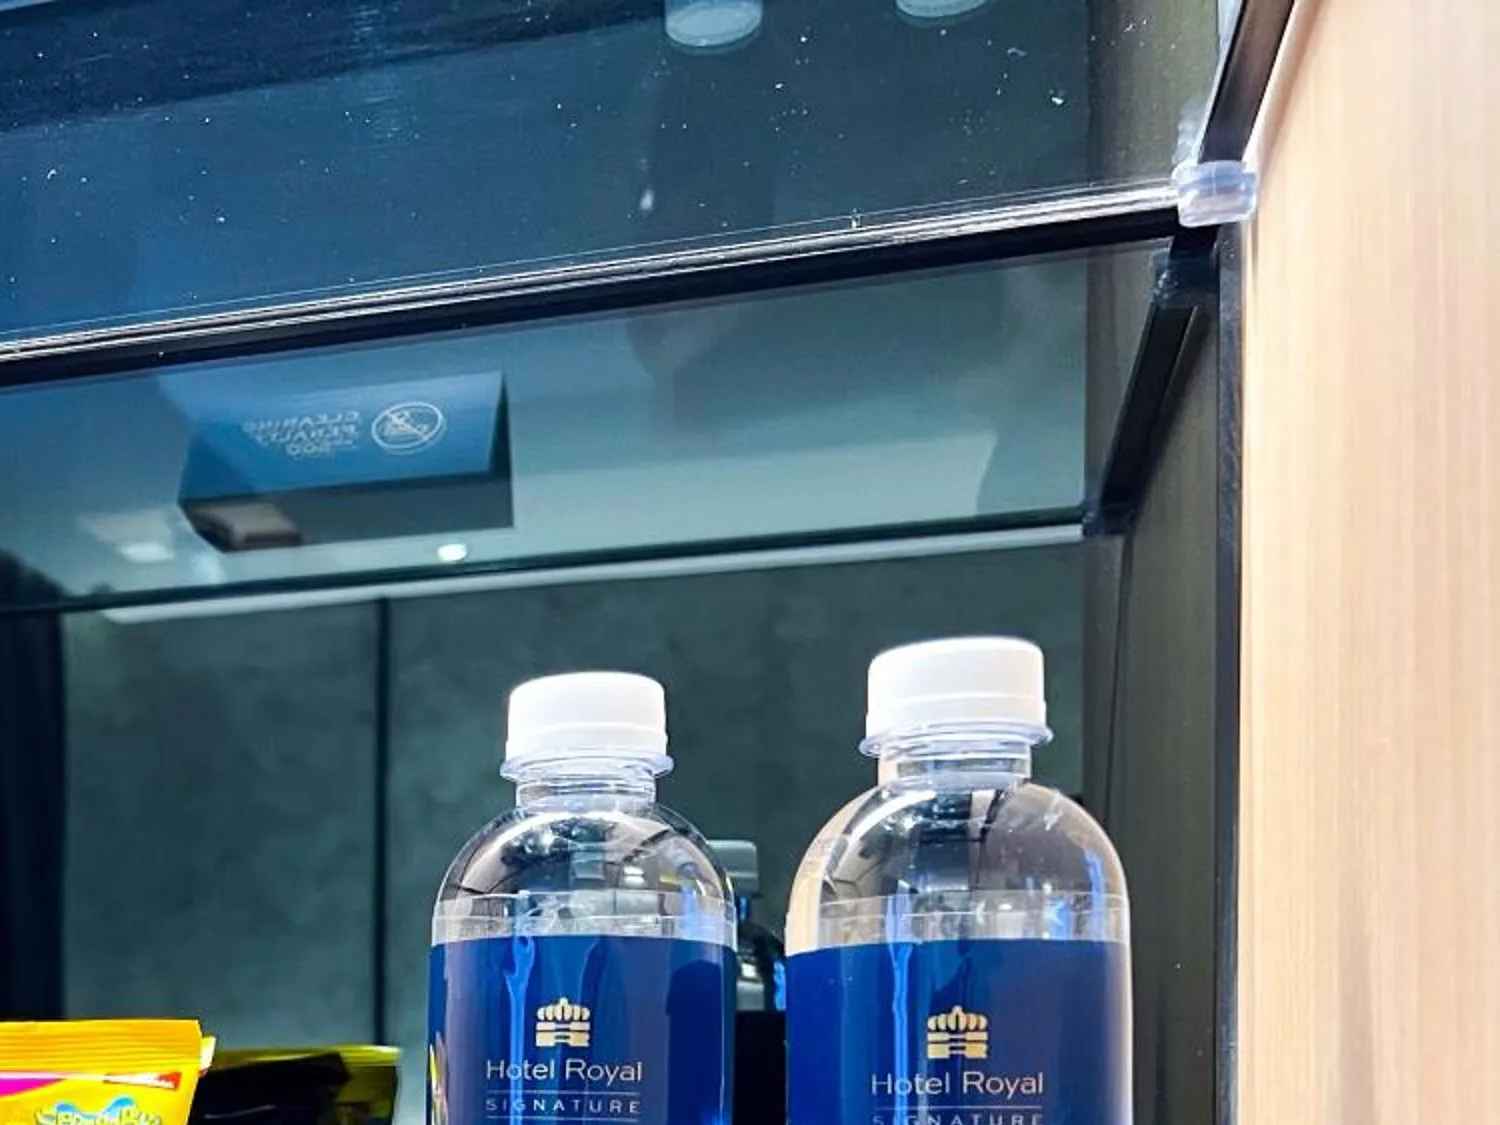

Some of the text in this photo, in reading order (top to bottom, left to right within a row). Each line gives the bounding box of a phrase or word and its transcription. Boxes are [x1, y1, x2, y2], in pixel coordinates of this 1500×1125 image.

[486, 1058, 643, 1086] Hotel Royal
[872, 1071, 1043, 1100] Hotel Royal
[485, 1099, 641, 1114] SIGNATURE
